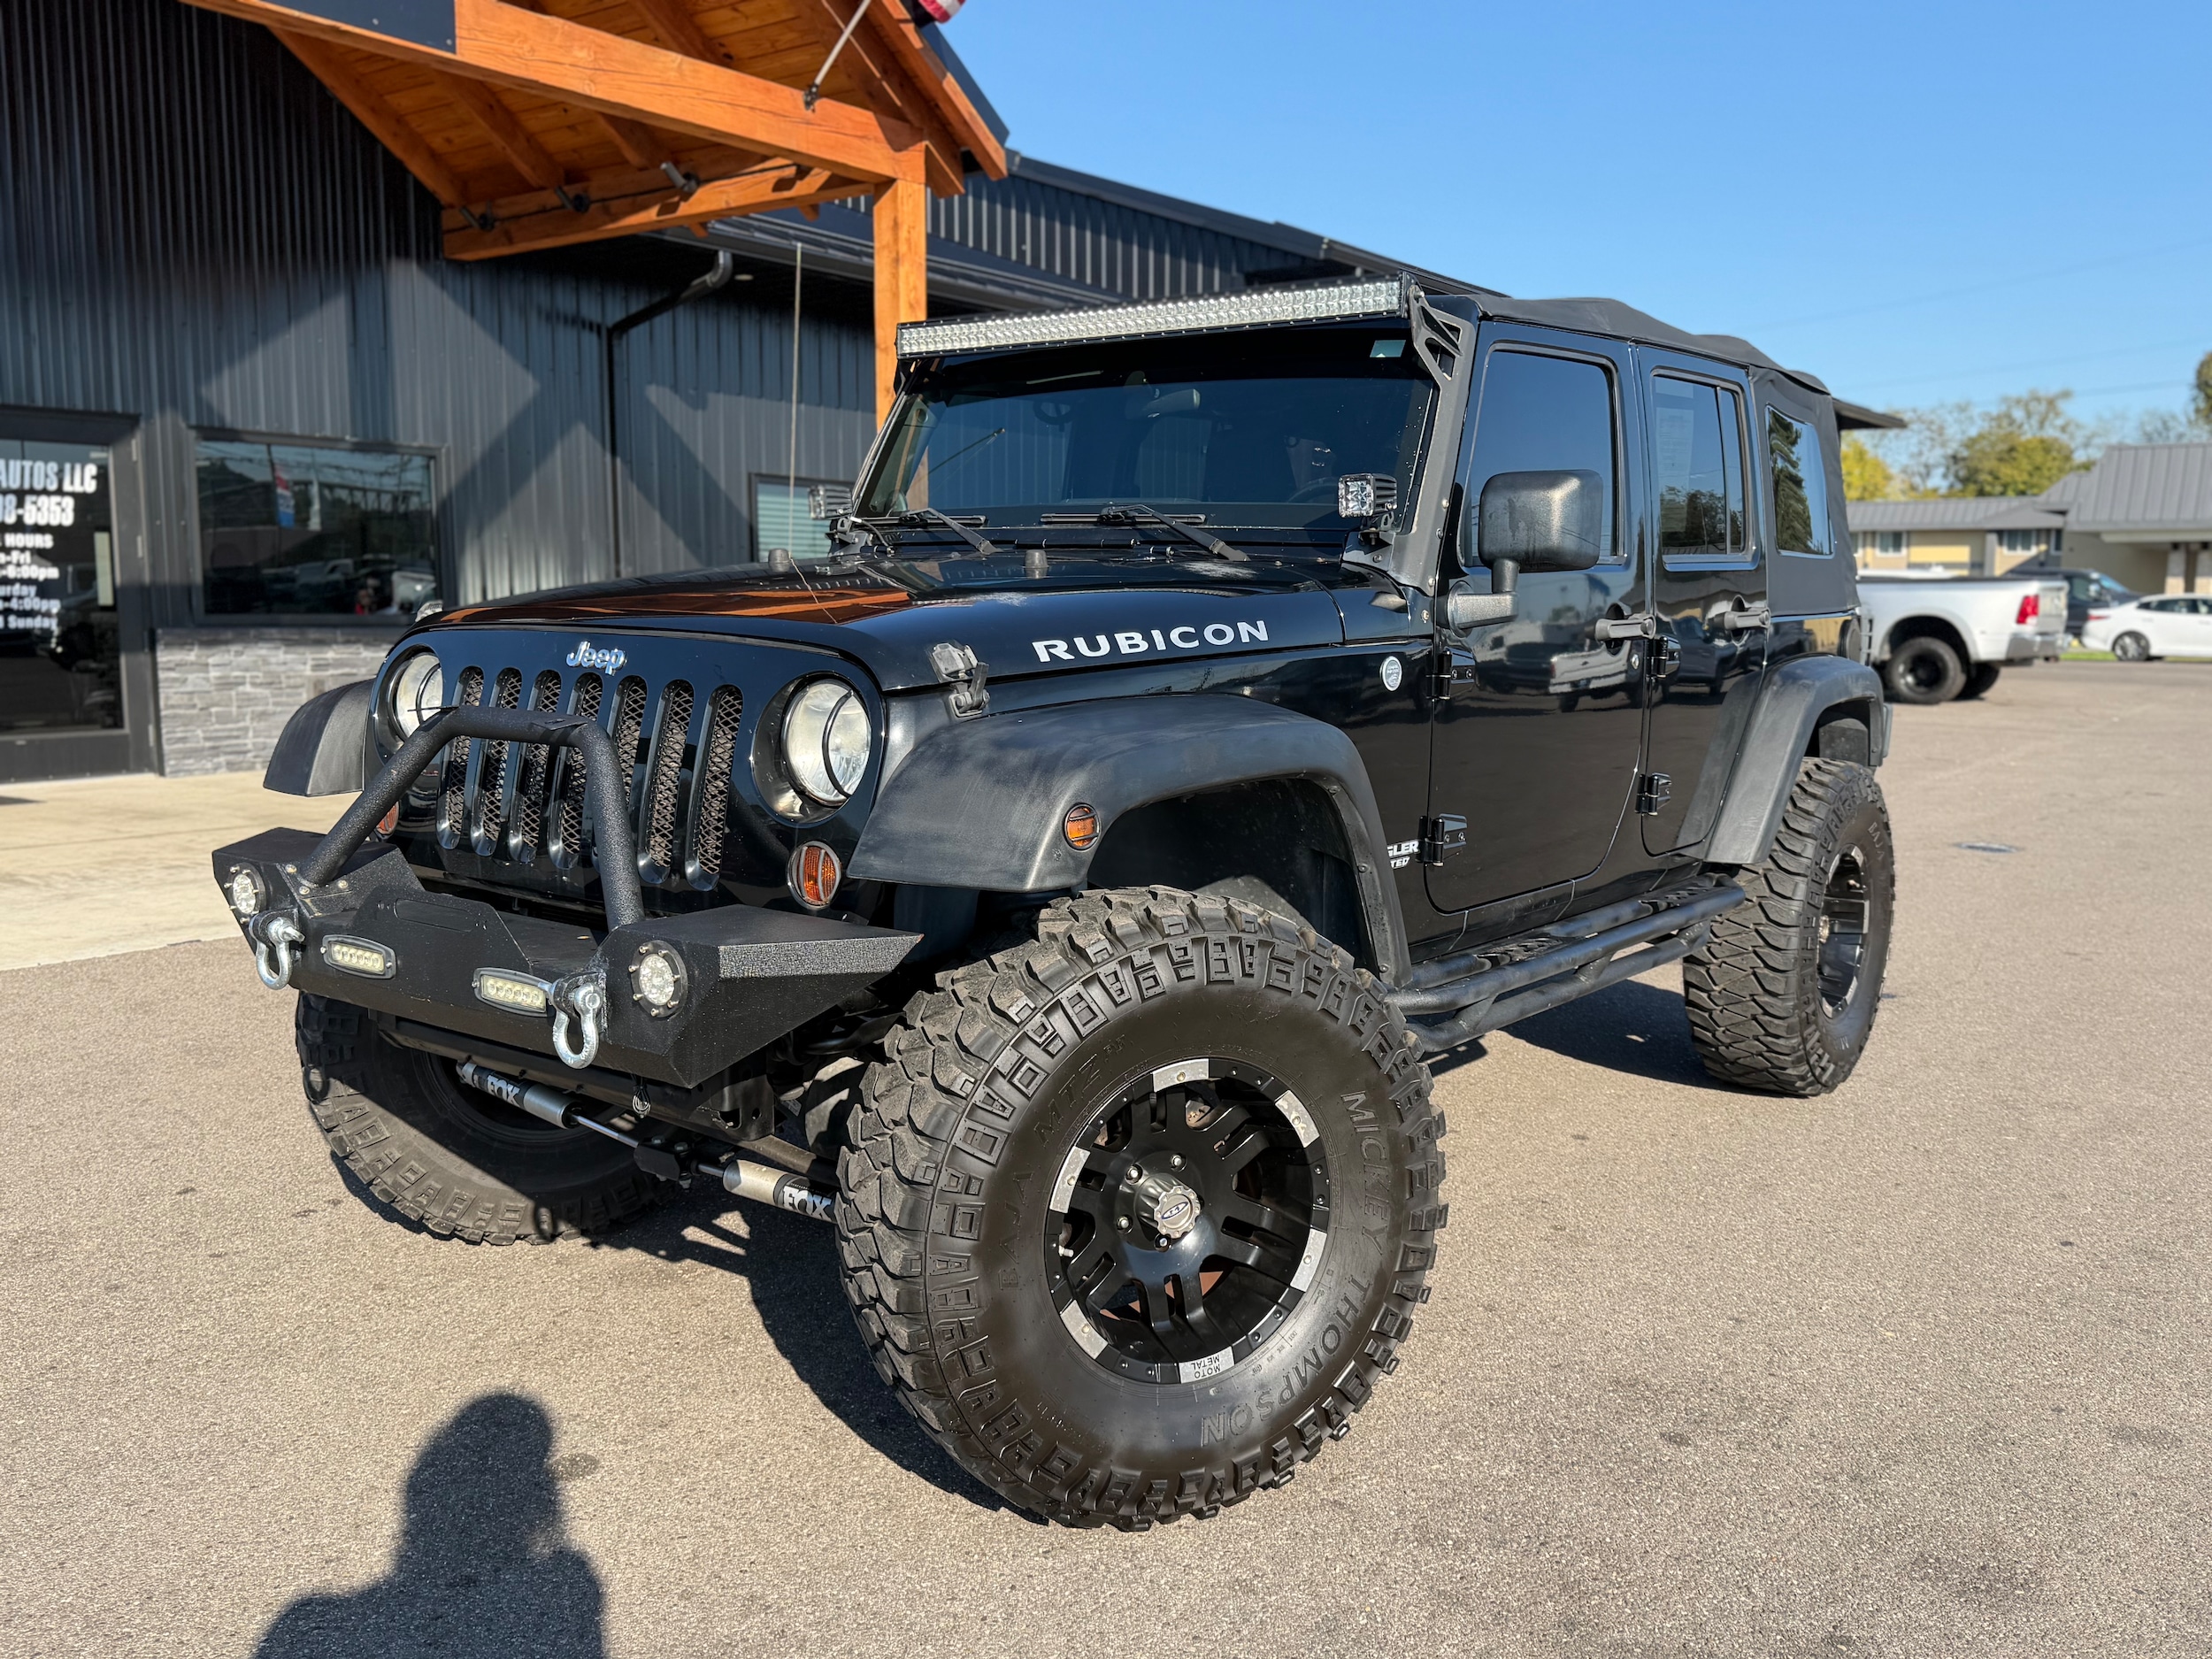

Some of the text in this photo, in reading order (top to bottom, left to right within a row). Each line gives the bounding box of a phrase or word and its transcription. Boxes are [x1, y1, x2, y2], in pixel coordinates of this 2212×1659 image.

[63, 463, 97, 494] LLC
[0, 494, 75, 526] 8-5353
[4, 533, 54, 549] HOURS
[7, 614, 58, 632] Sunday
[1032, 620, 1269, 662] RUBICON
[566, 641, 626, 676] Jeep
[488, 1075, 520, 1108] FOX
[784, 1186, 832, 1221] FOX
[1201, 1090, 1391, 1448] MICKEY THOMPSON
[1191, 1355, 1220, 1371] METAL
[1194, 1363, 1221, 1379] MOTO
